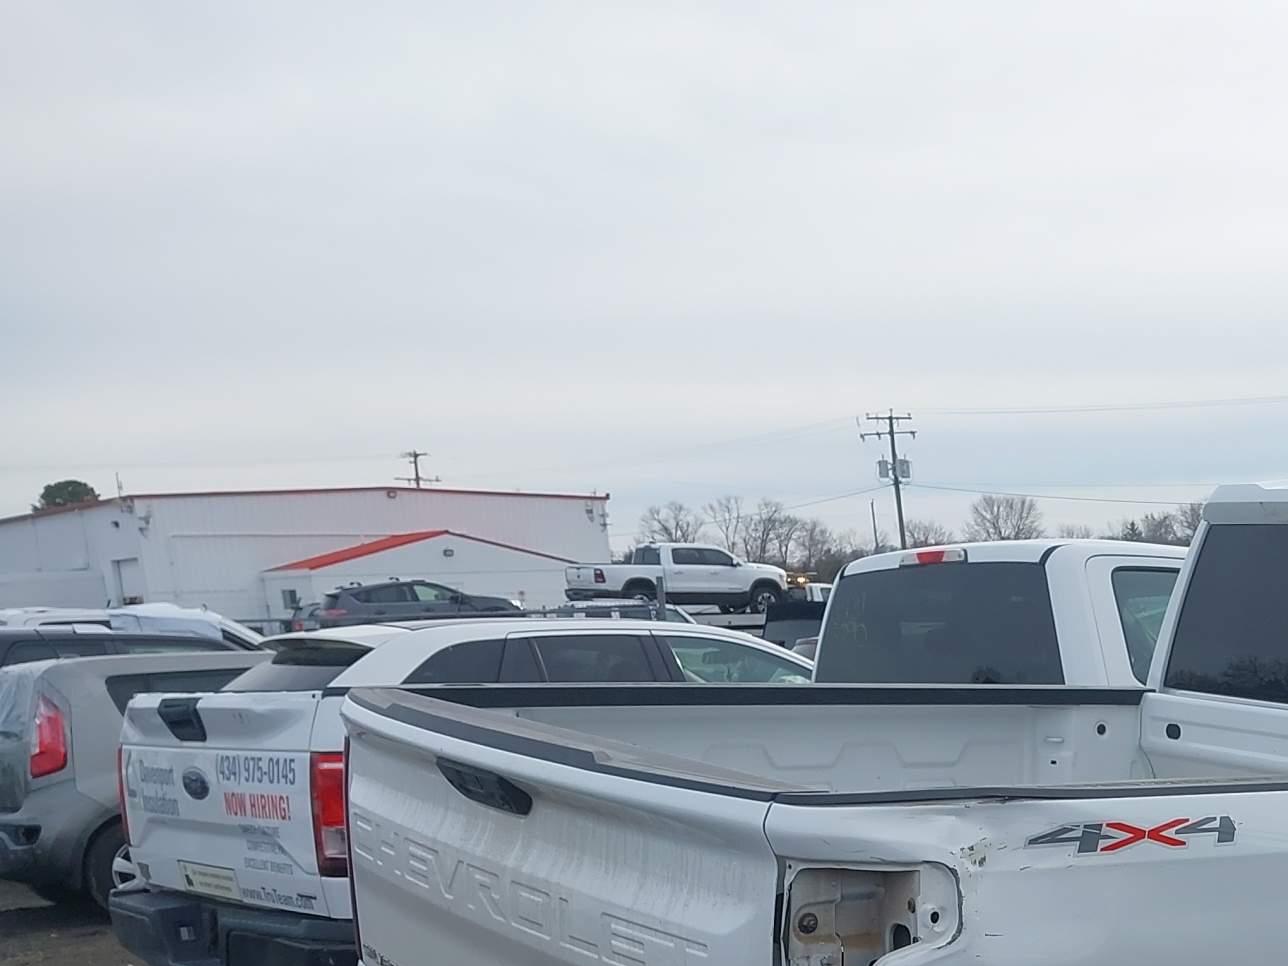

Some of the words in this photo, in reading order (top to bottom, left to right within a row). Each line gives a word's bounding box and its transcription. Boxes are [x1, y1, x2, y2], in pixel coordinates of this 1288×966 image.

[215, 753, 241, 785] (434)
[244, 757, 296, 786] 975-0145
[224, 792, 247, 817] NOW
[250, 793, 291, 821] HIRING!
